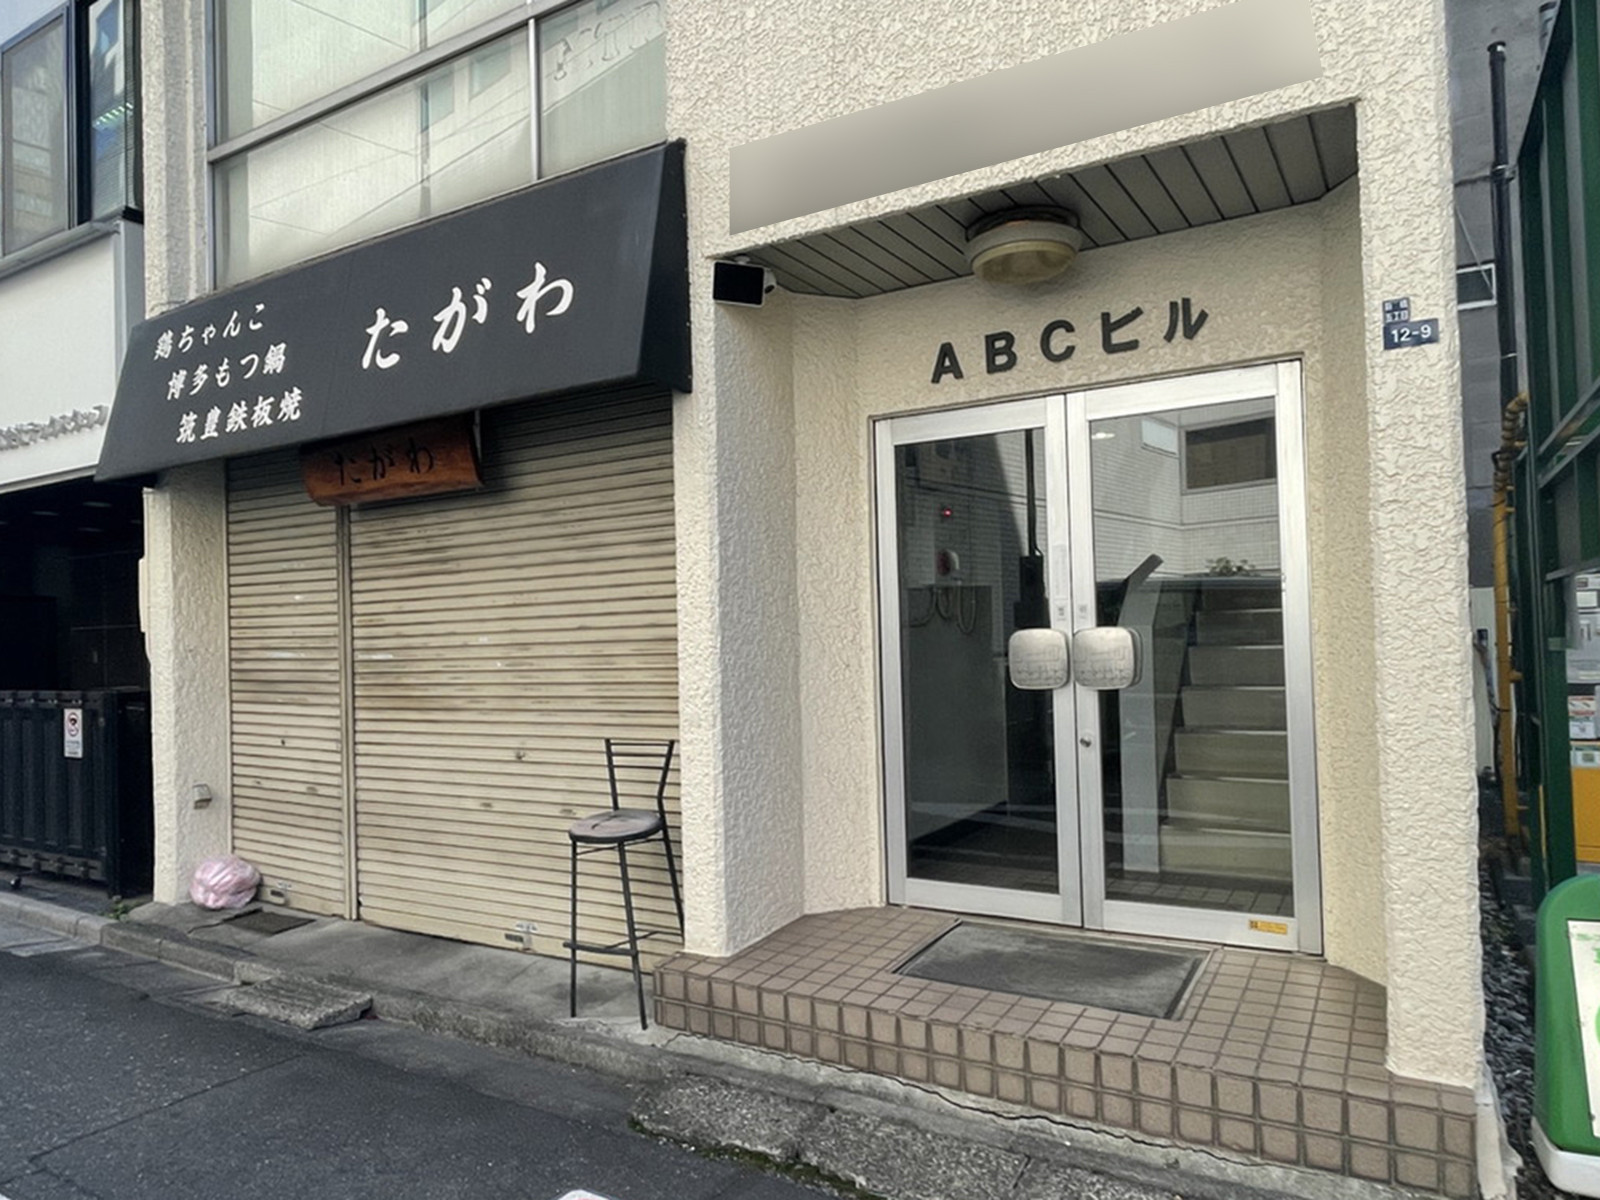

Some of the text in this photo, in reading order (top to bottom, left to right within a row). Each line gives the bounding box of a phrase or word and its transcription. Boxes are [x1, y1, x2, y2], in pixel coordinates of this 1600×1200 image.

[362, 262, 574, 370] たがわ
[1391, 324, 1432, 343] 12-9
[167, 342, 287, 401] 博多もつ鍋
[176, 386, 303, 444] 筑豊鉄板焼
[334, 437, 435, 486] たがわ
